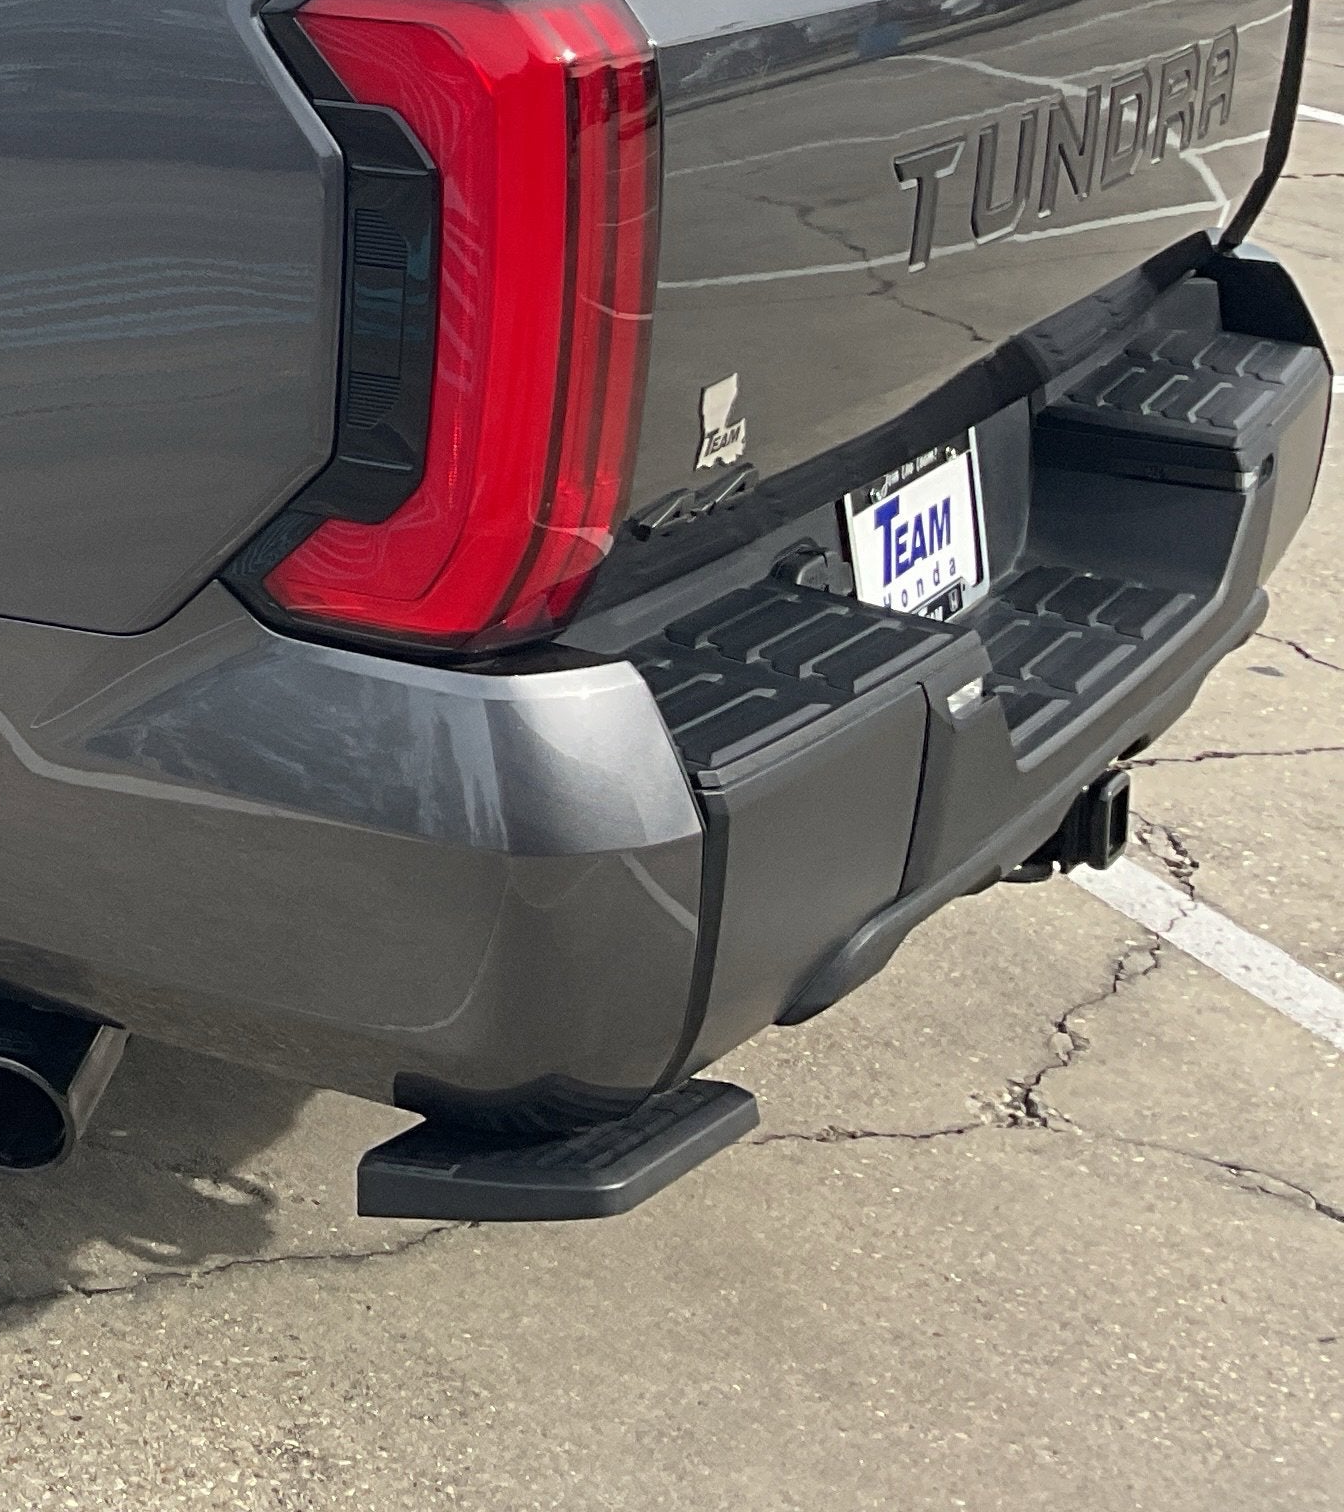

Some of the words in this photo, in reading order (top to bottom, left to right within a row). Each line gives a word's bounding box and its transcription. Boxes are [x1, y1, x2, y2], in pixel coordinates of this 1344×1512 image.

[892, 24, 1238, 273] TUNDRA
[705, 427, 740, 457] TEAM
[873, 495, 951, 586] TEAM
[883, 556, 957, 610] Honda
